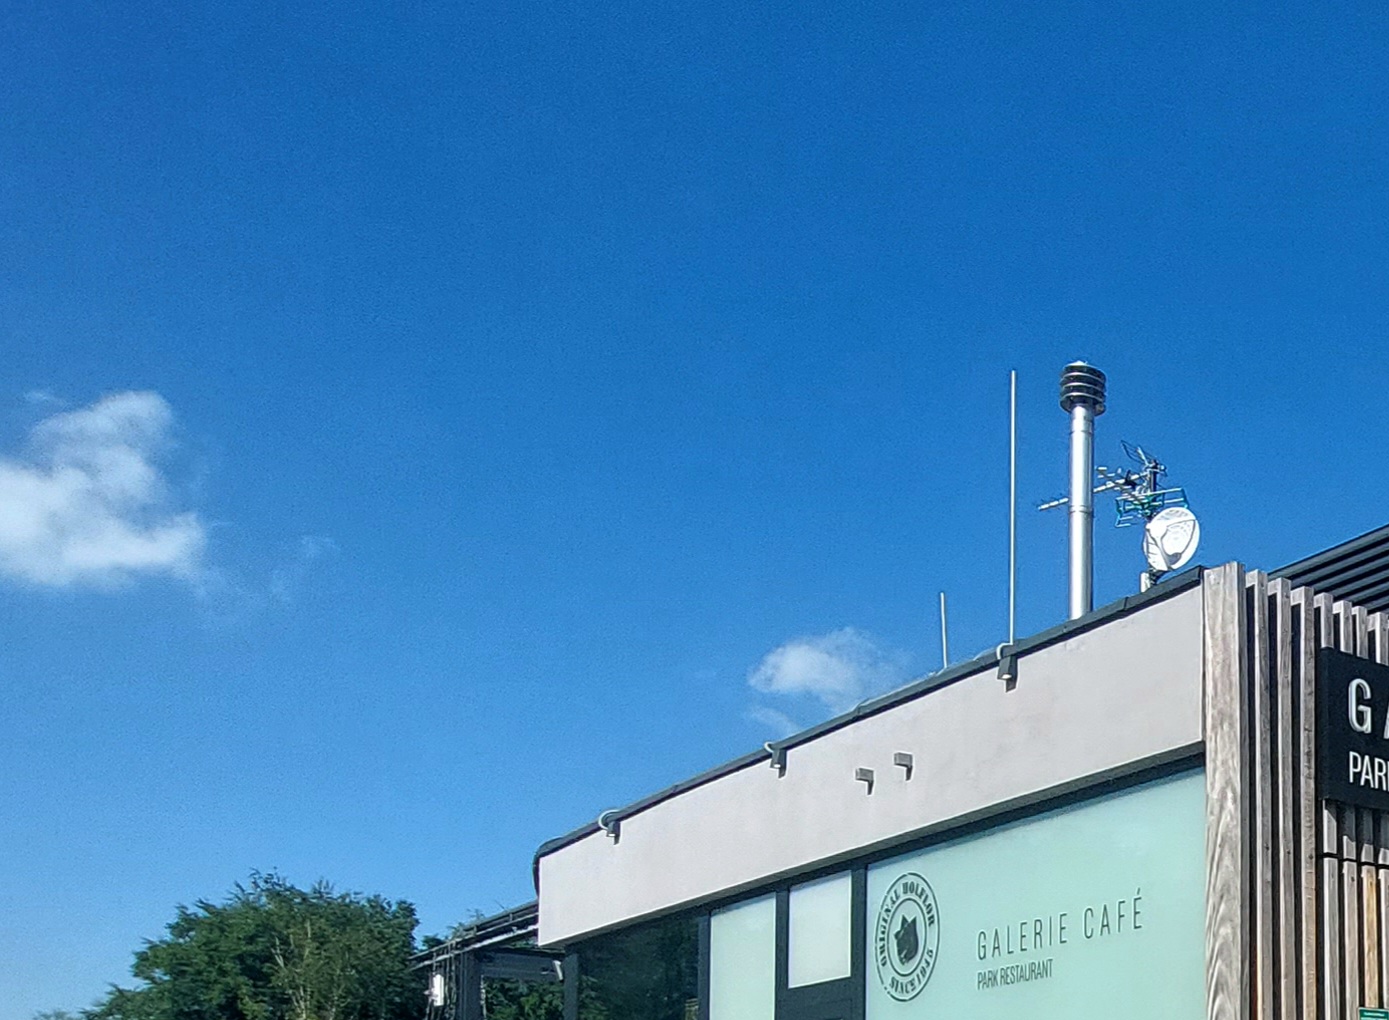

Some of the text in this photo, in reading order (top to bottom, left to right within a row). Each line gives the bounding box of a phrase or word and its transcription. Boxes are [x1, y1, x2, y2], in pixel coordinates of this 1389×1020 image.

[977, 887, 1143, 961] GALERIE CAFÉ
[977, 958, 1054, 991] PARK RESTAURANT
